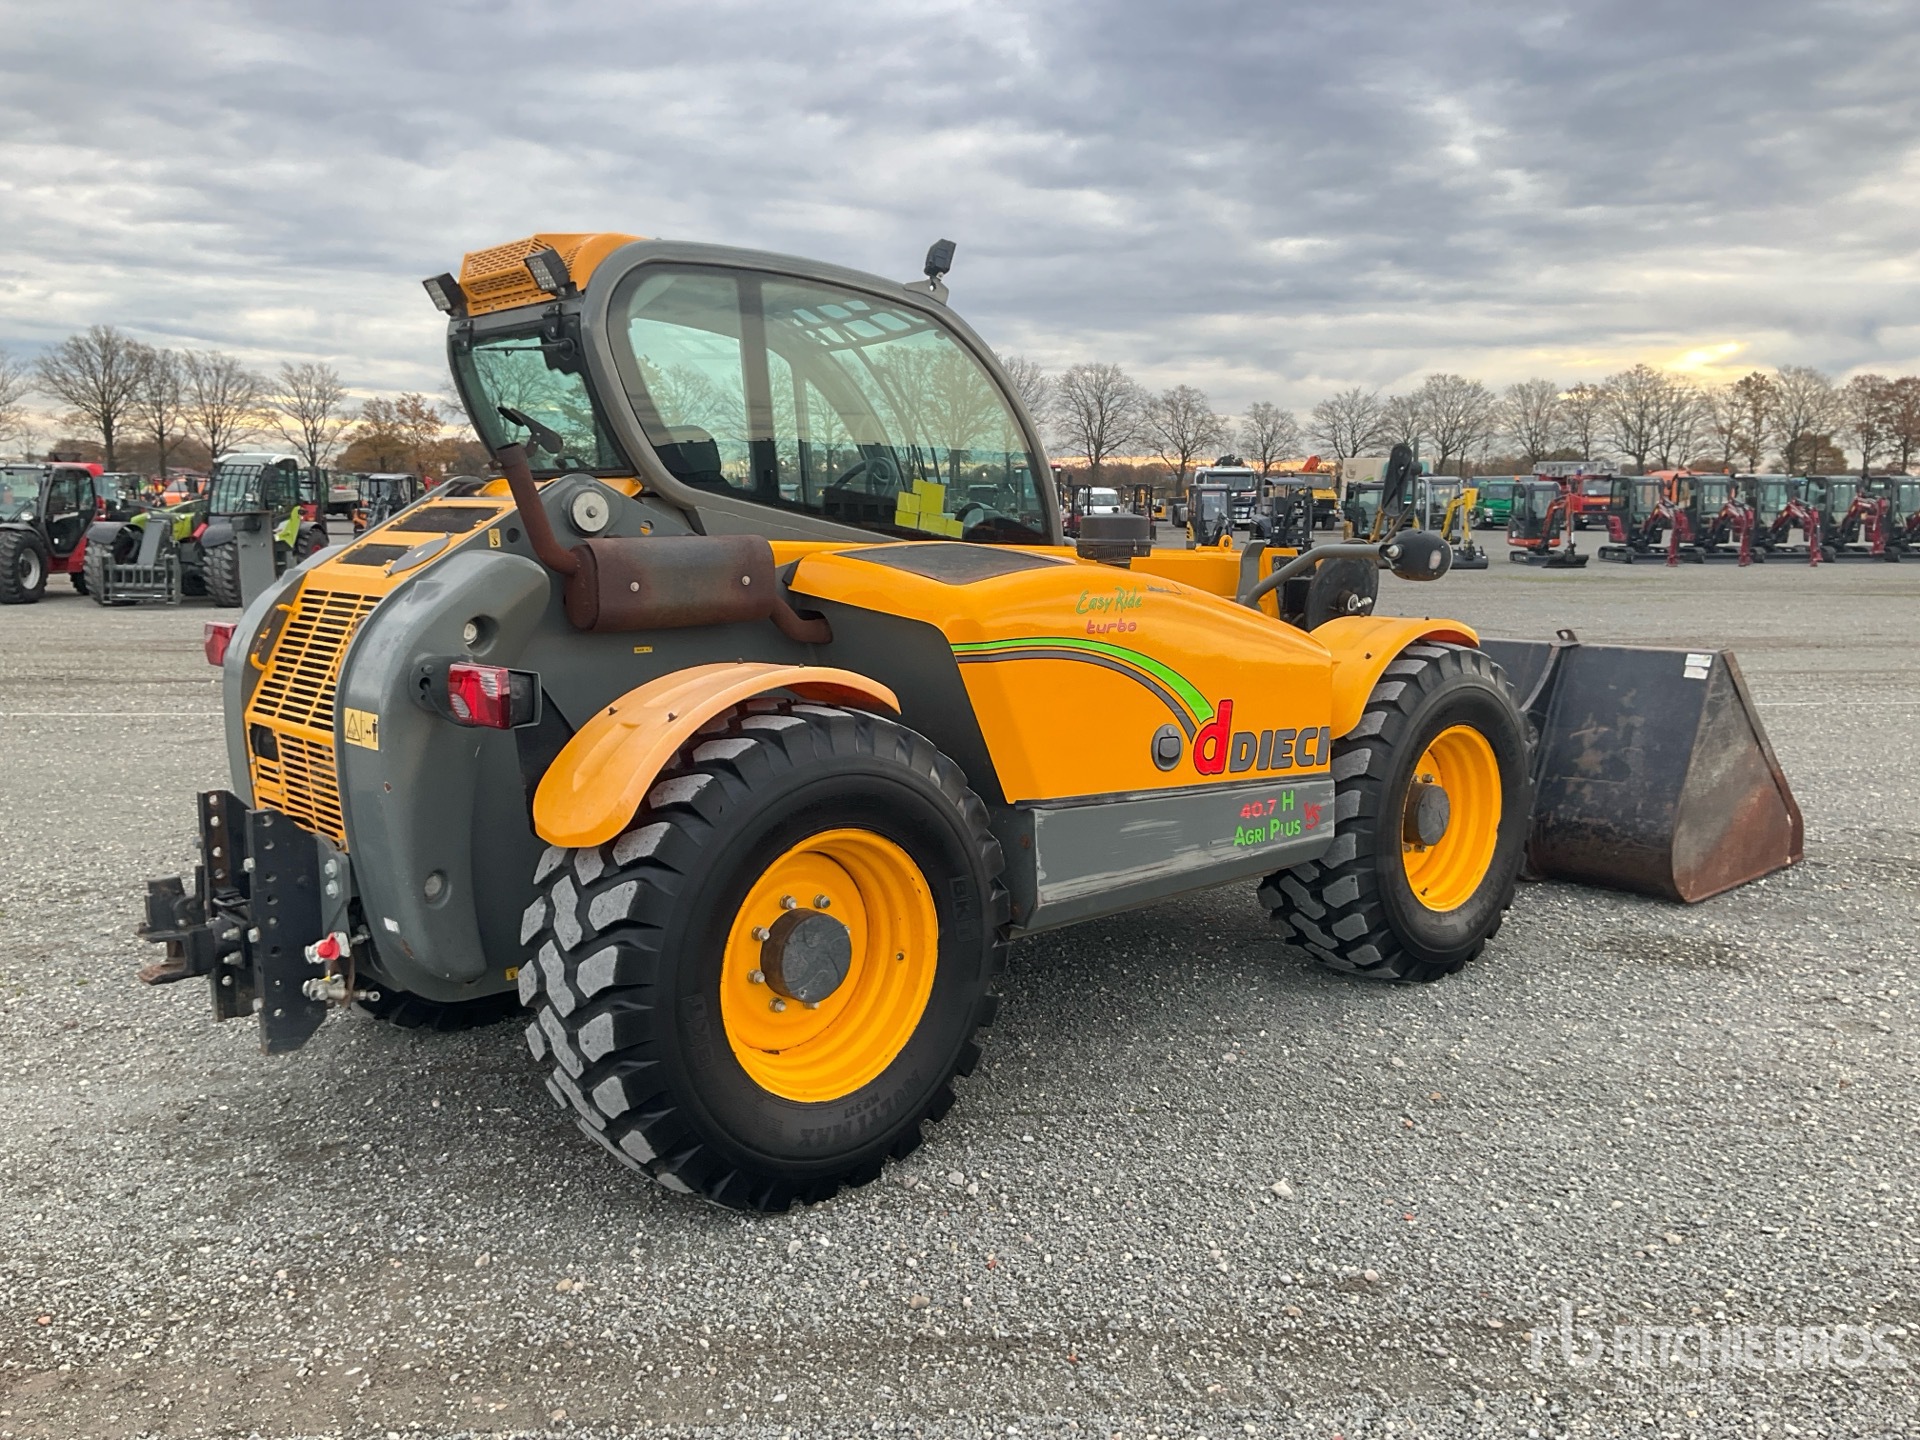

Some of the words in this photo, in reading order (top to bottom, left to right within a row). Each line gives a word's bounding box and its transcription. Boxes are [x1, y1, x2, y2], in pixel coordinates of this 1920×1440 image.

[1076, 590, 1113, 614] Easy
[1114, 586, 1142, 613] Ride
[1086, 618, 1136, 634] turbo
[1229, 726, 1331, 773] DIECI
[1240, 799, 1277, 819] 40.7
[1282, 789, 1294, 812] H
